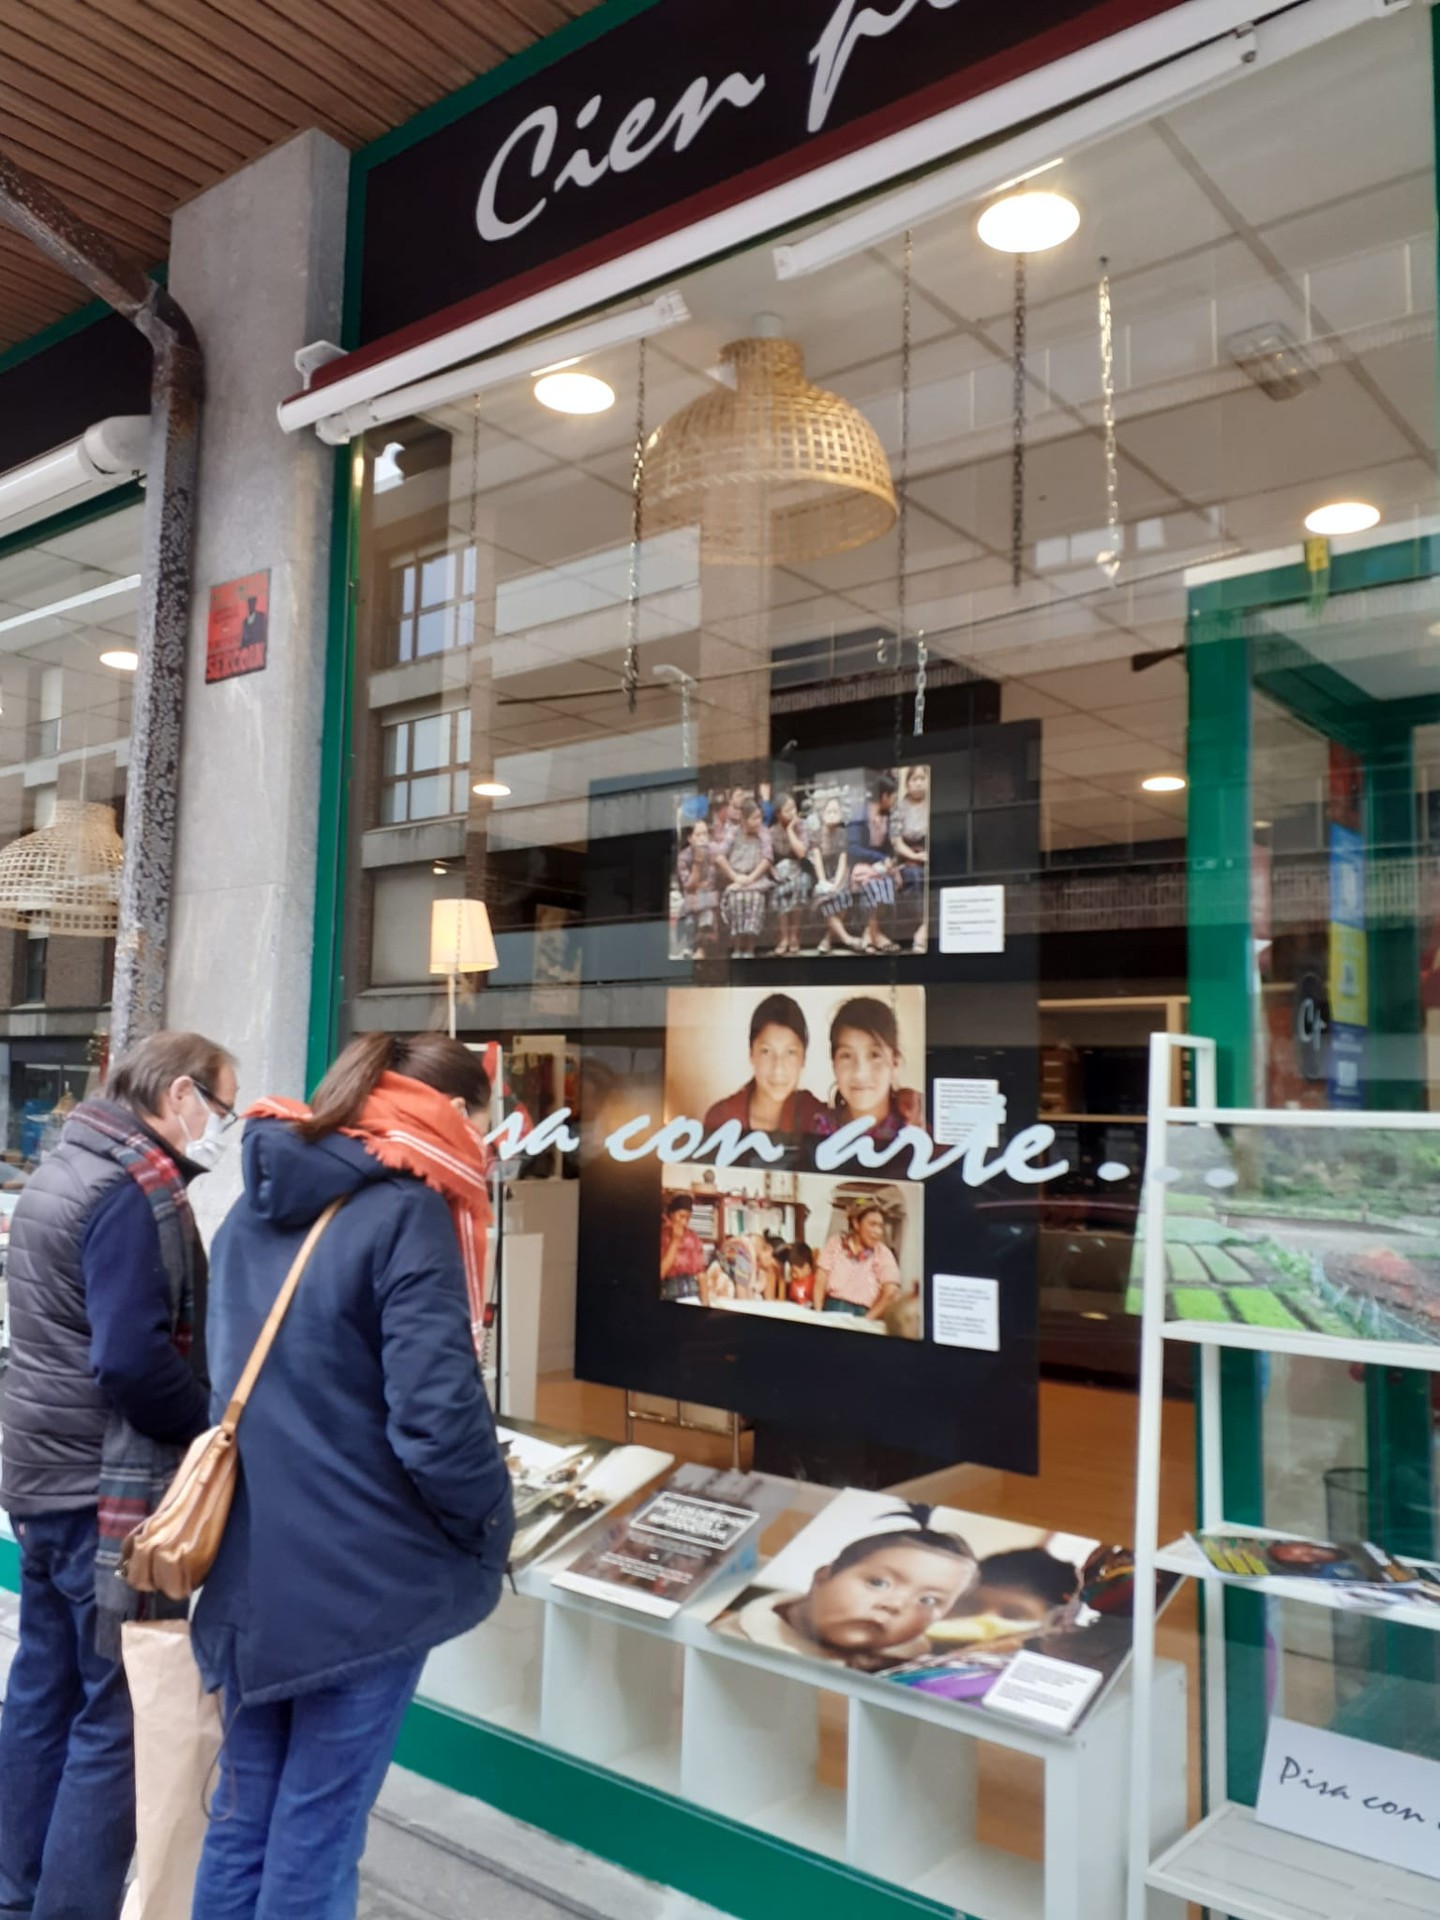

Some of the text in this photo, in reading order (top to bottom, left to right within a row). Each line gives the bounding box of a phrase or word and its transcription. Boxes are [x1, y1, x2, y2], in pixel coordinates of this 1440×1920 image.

[476, 0, 961, 242] Cien p
[484, 1107, 581, 1161] sa
[605, 1114, 784, 1168] con
[1362, 1796, 1426, 1822] con
